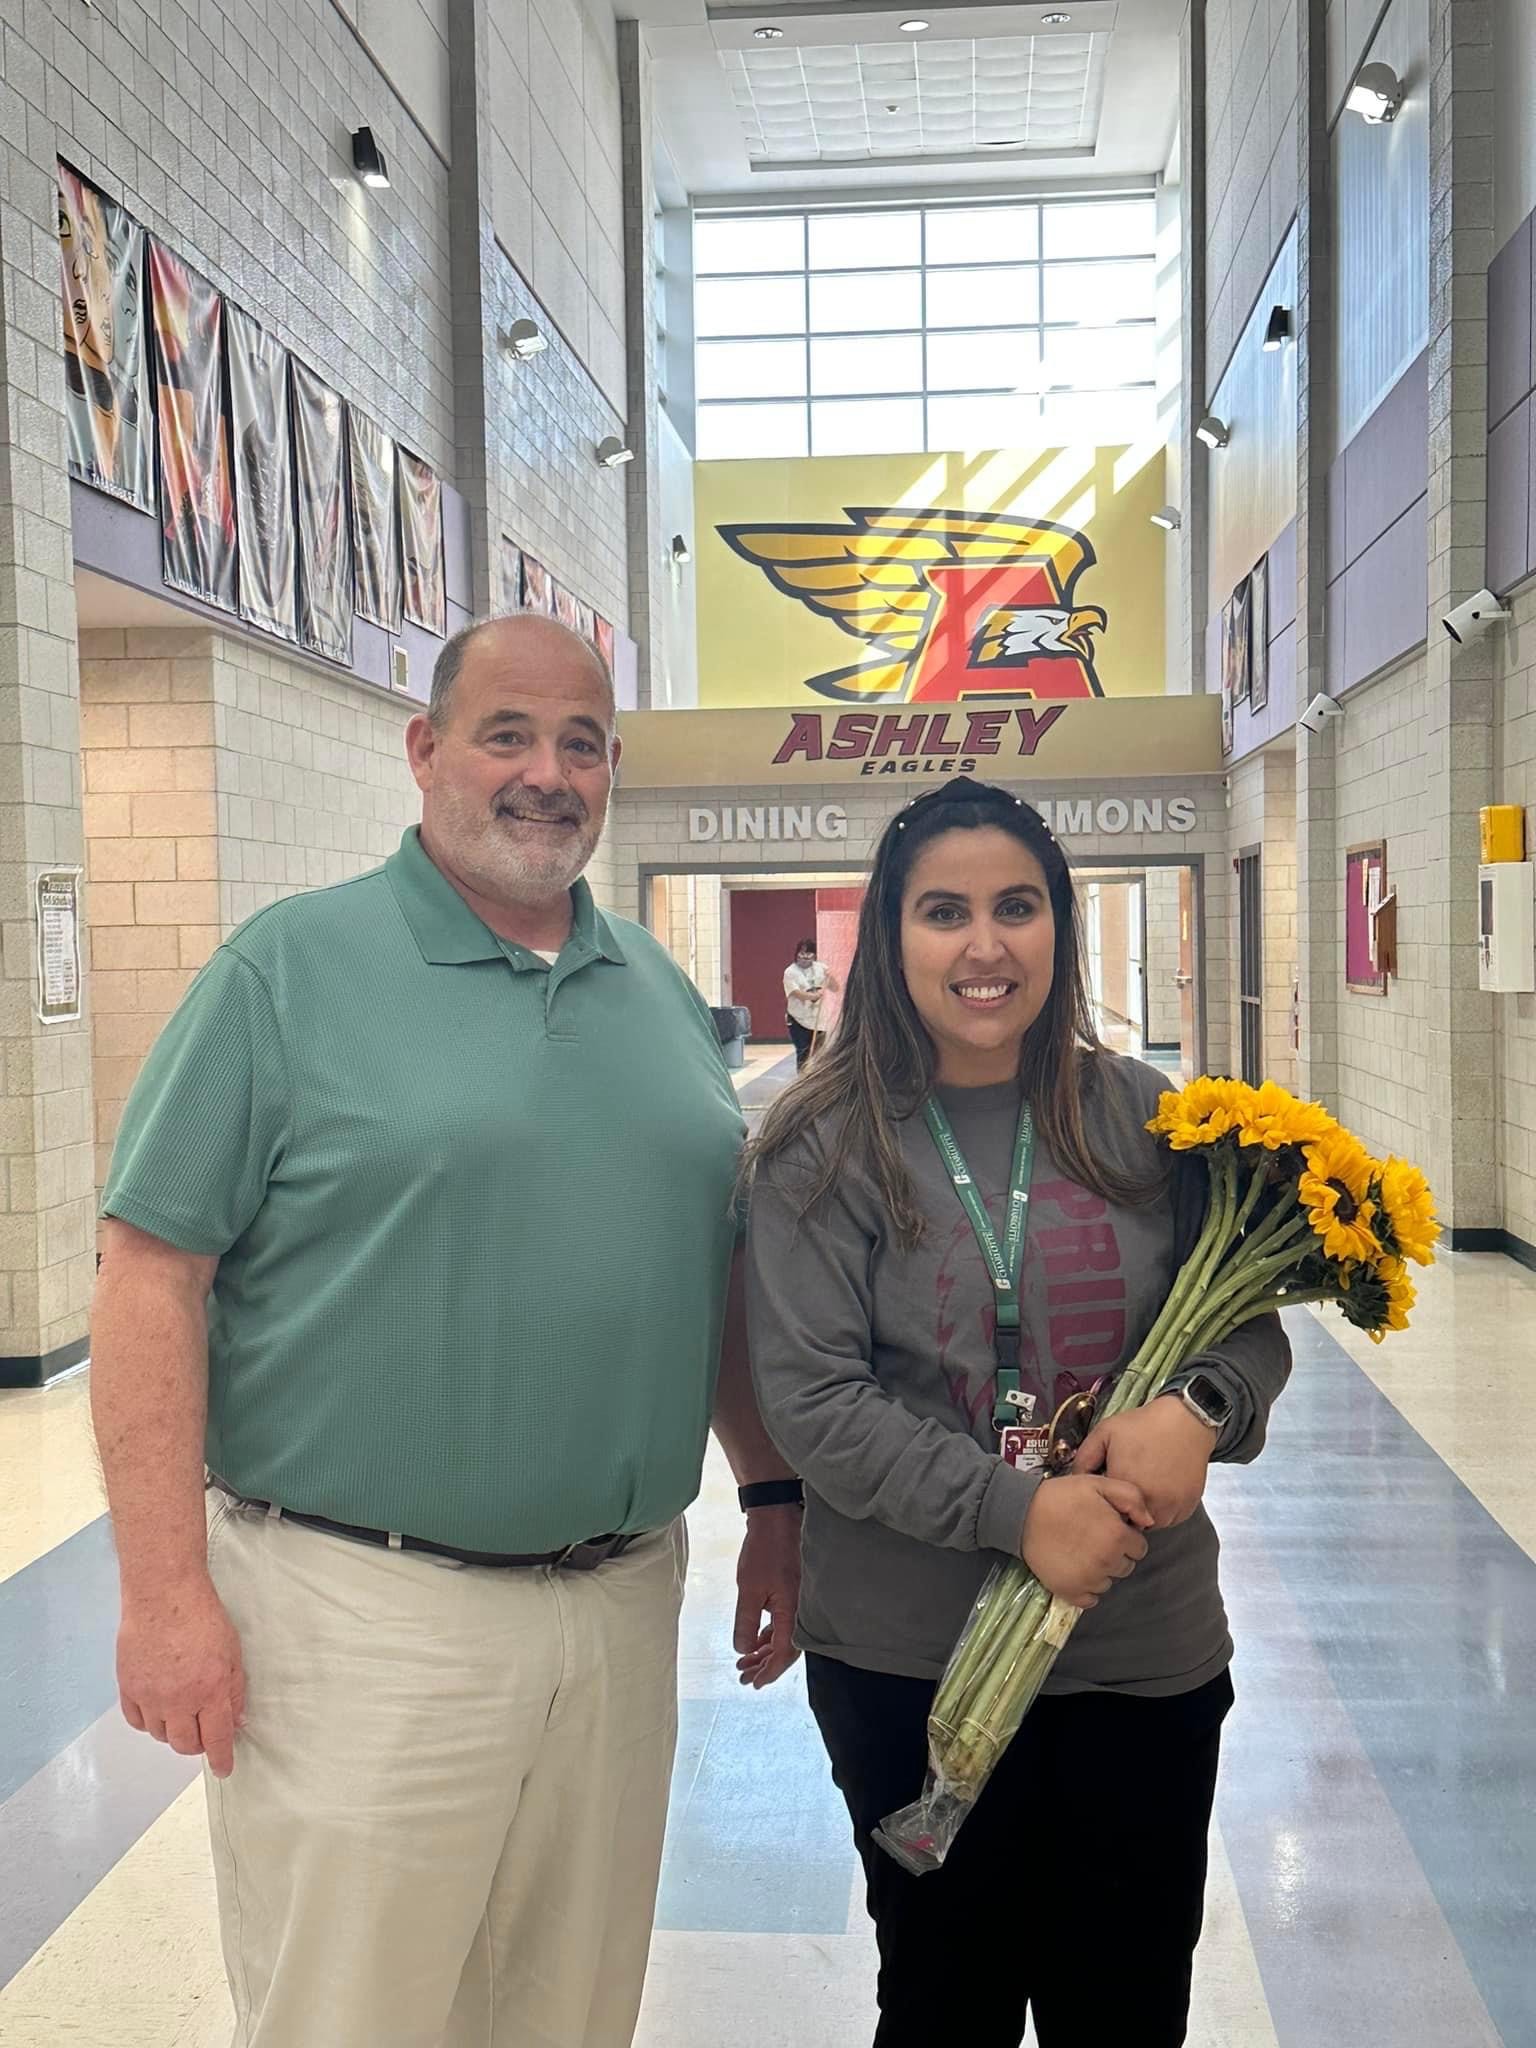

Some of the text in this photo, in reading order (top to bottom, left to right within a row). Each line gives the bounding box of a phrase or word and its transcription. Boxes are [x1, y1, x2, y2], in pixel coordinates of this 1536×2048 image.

[772, 705, 1067, 764] ASHLEY
[861, 758, 976, 776] EAGLES
[689, 804, 848, 841] DINING
